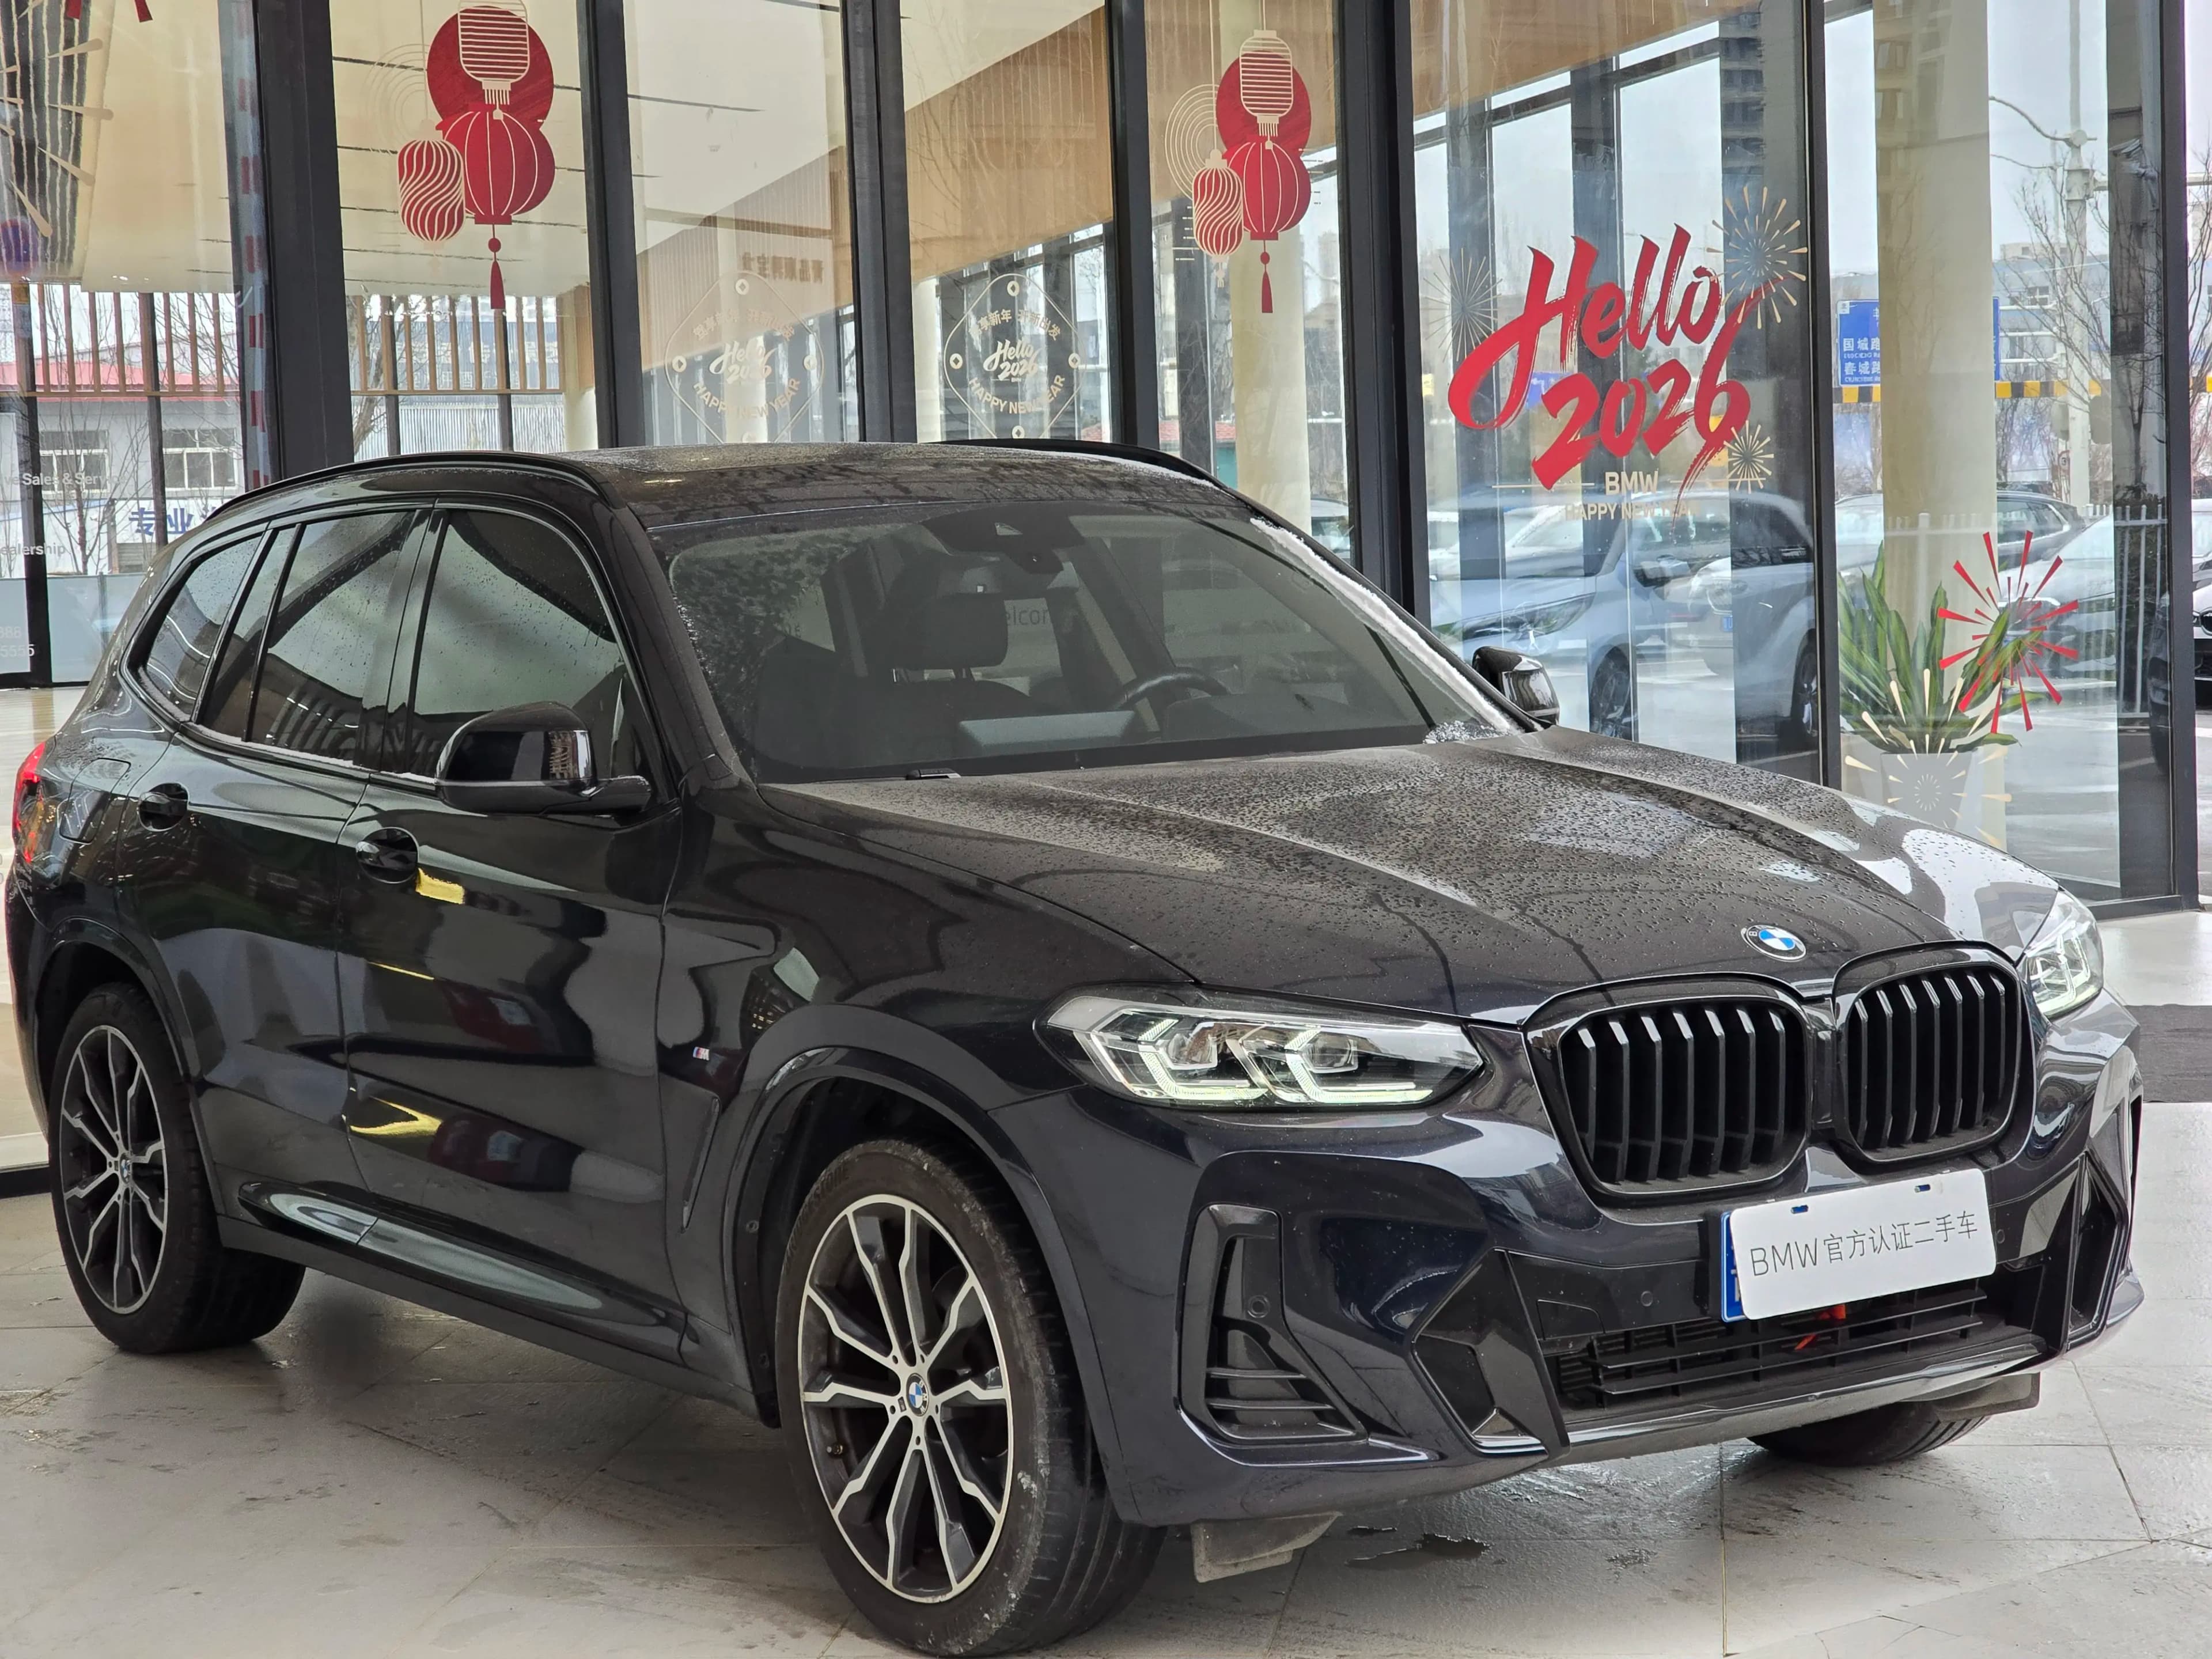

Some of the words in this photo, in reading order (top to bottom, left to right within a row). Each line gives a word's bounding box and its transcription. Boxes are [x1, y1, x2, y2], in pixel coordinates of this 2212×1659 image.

[1448, 223, 1722, 430] Hello
[983, 339, 1034, 372] Hello
[998, 348, 1042, 381] 2026
[768, 378, 801, 412] YEAR
[969, 377, 1007, 412] HAPPY
[1009, 401, 1036, 414] NEW
[1531, 275, 1793, 533] 2026
[22, 473, 59, 486] Sales
[62, 472, 73, 485] &
[1605, 471, 1658, 495] BMW
[1565, 502, 1616, 521] HAPPY
[1621, 501, 1654, 520] NEW
